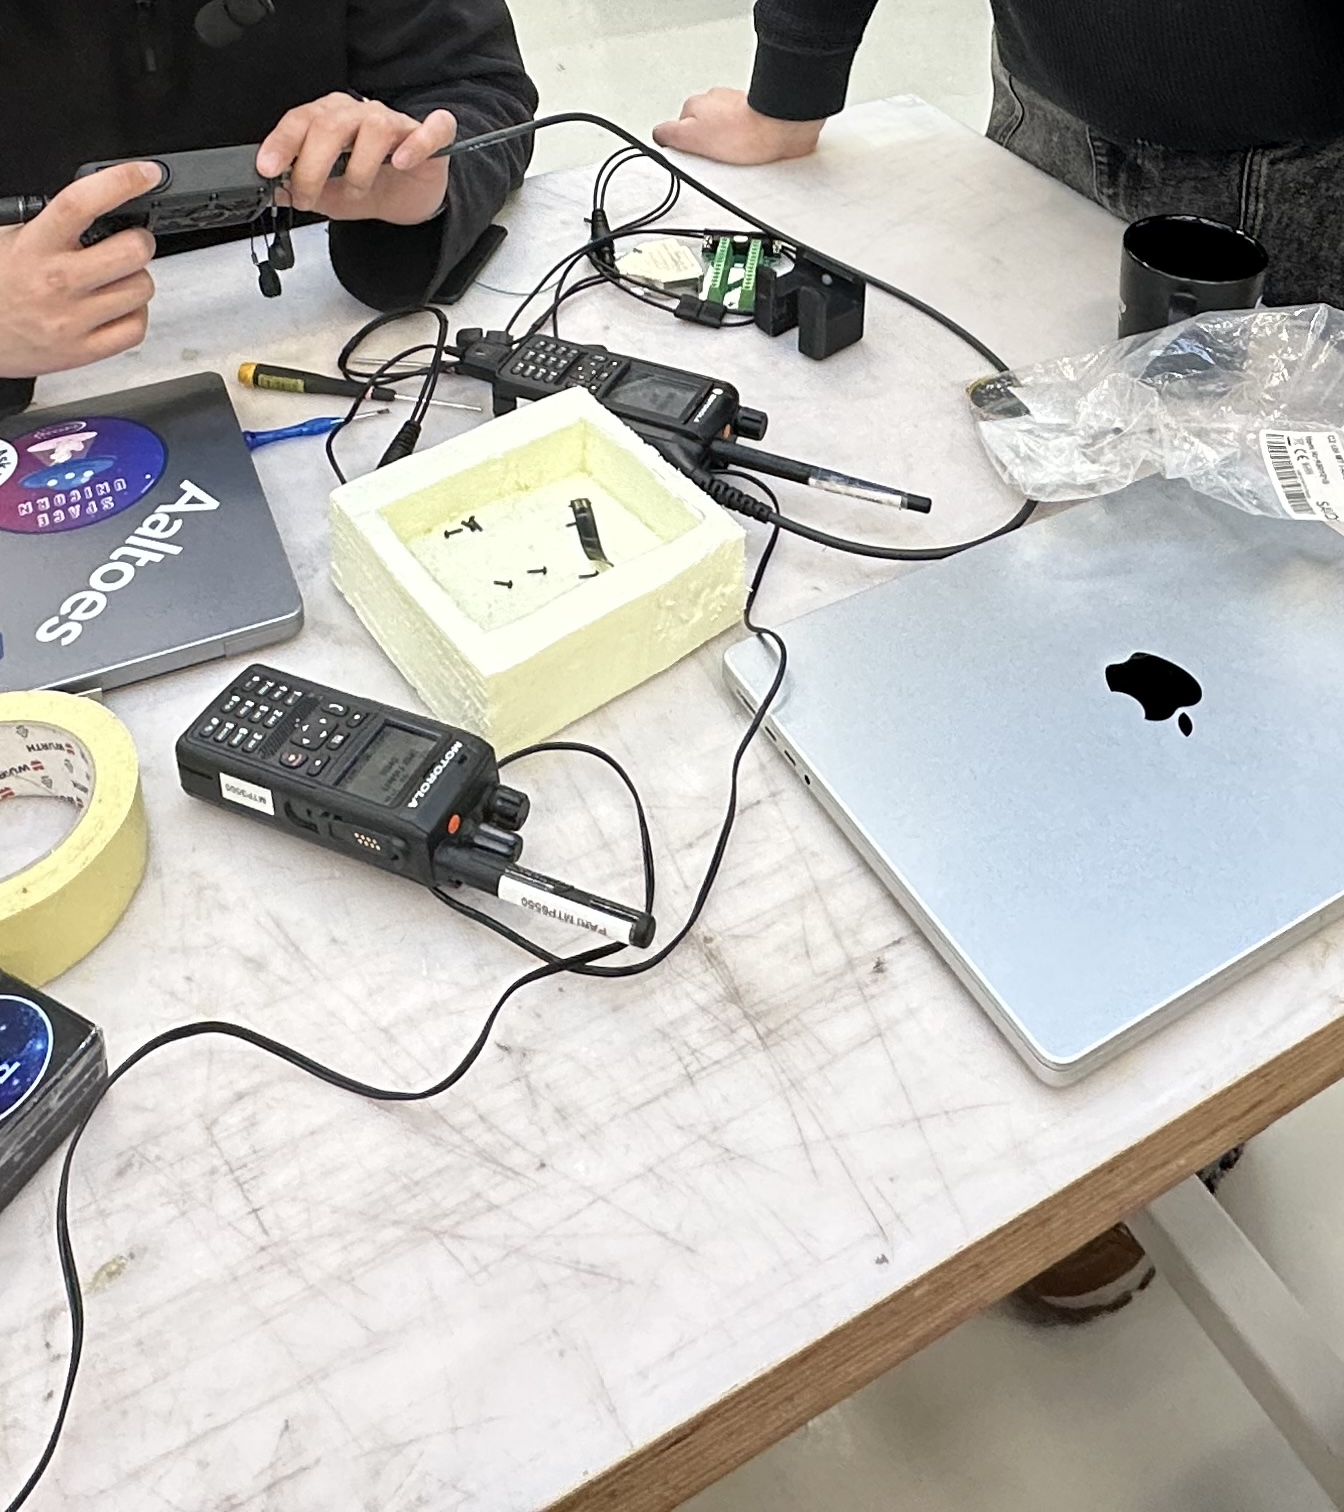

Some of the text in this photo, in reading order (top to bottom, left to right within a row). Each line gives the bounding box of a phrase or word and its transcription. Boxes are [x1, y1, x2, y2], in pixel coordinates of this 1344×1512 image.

[17, 478, 128, 517] UNICORN
[37, 495, 115, 529] SPACE
[35, 479, 221, 647] Aaltoes
[406, 741, 465, 809] MOTOROLA
